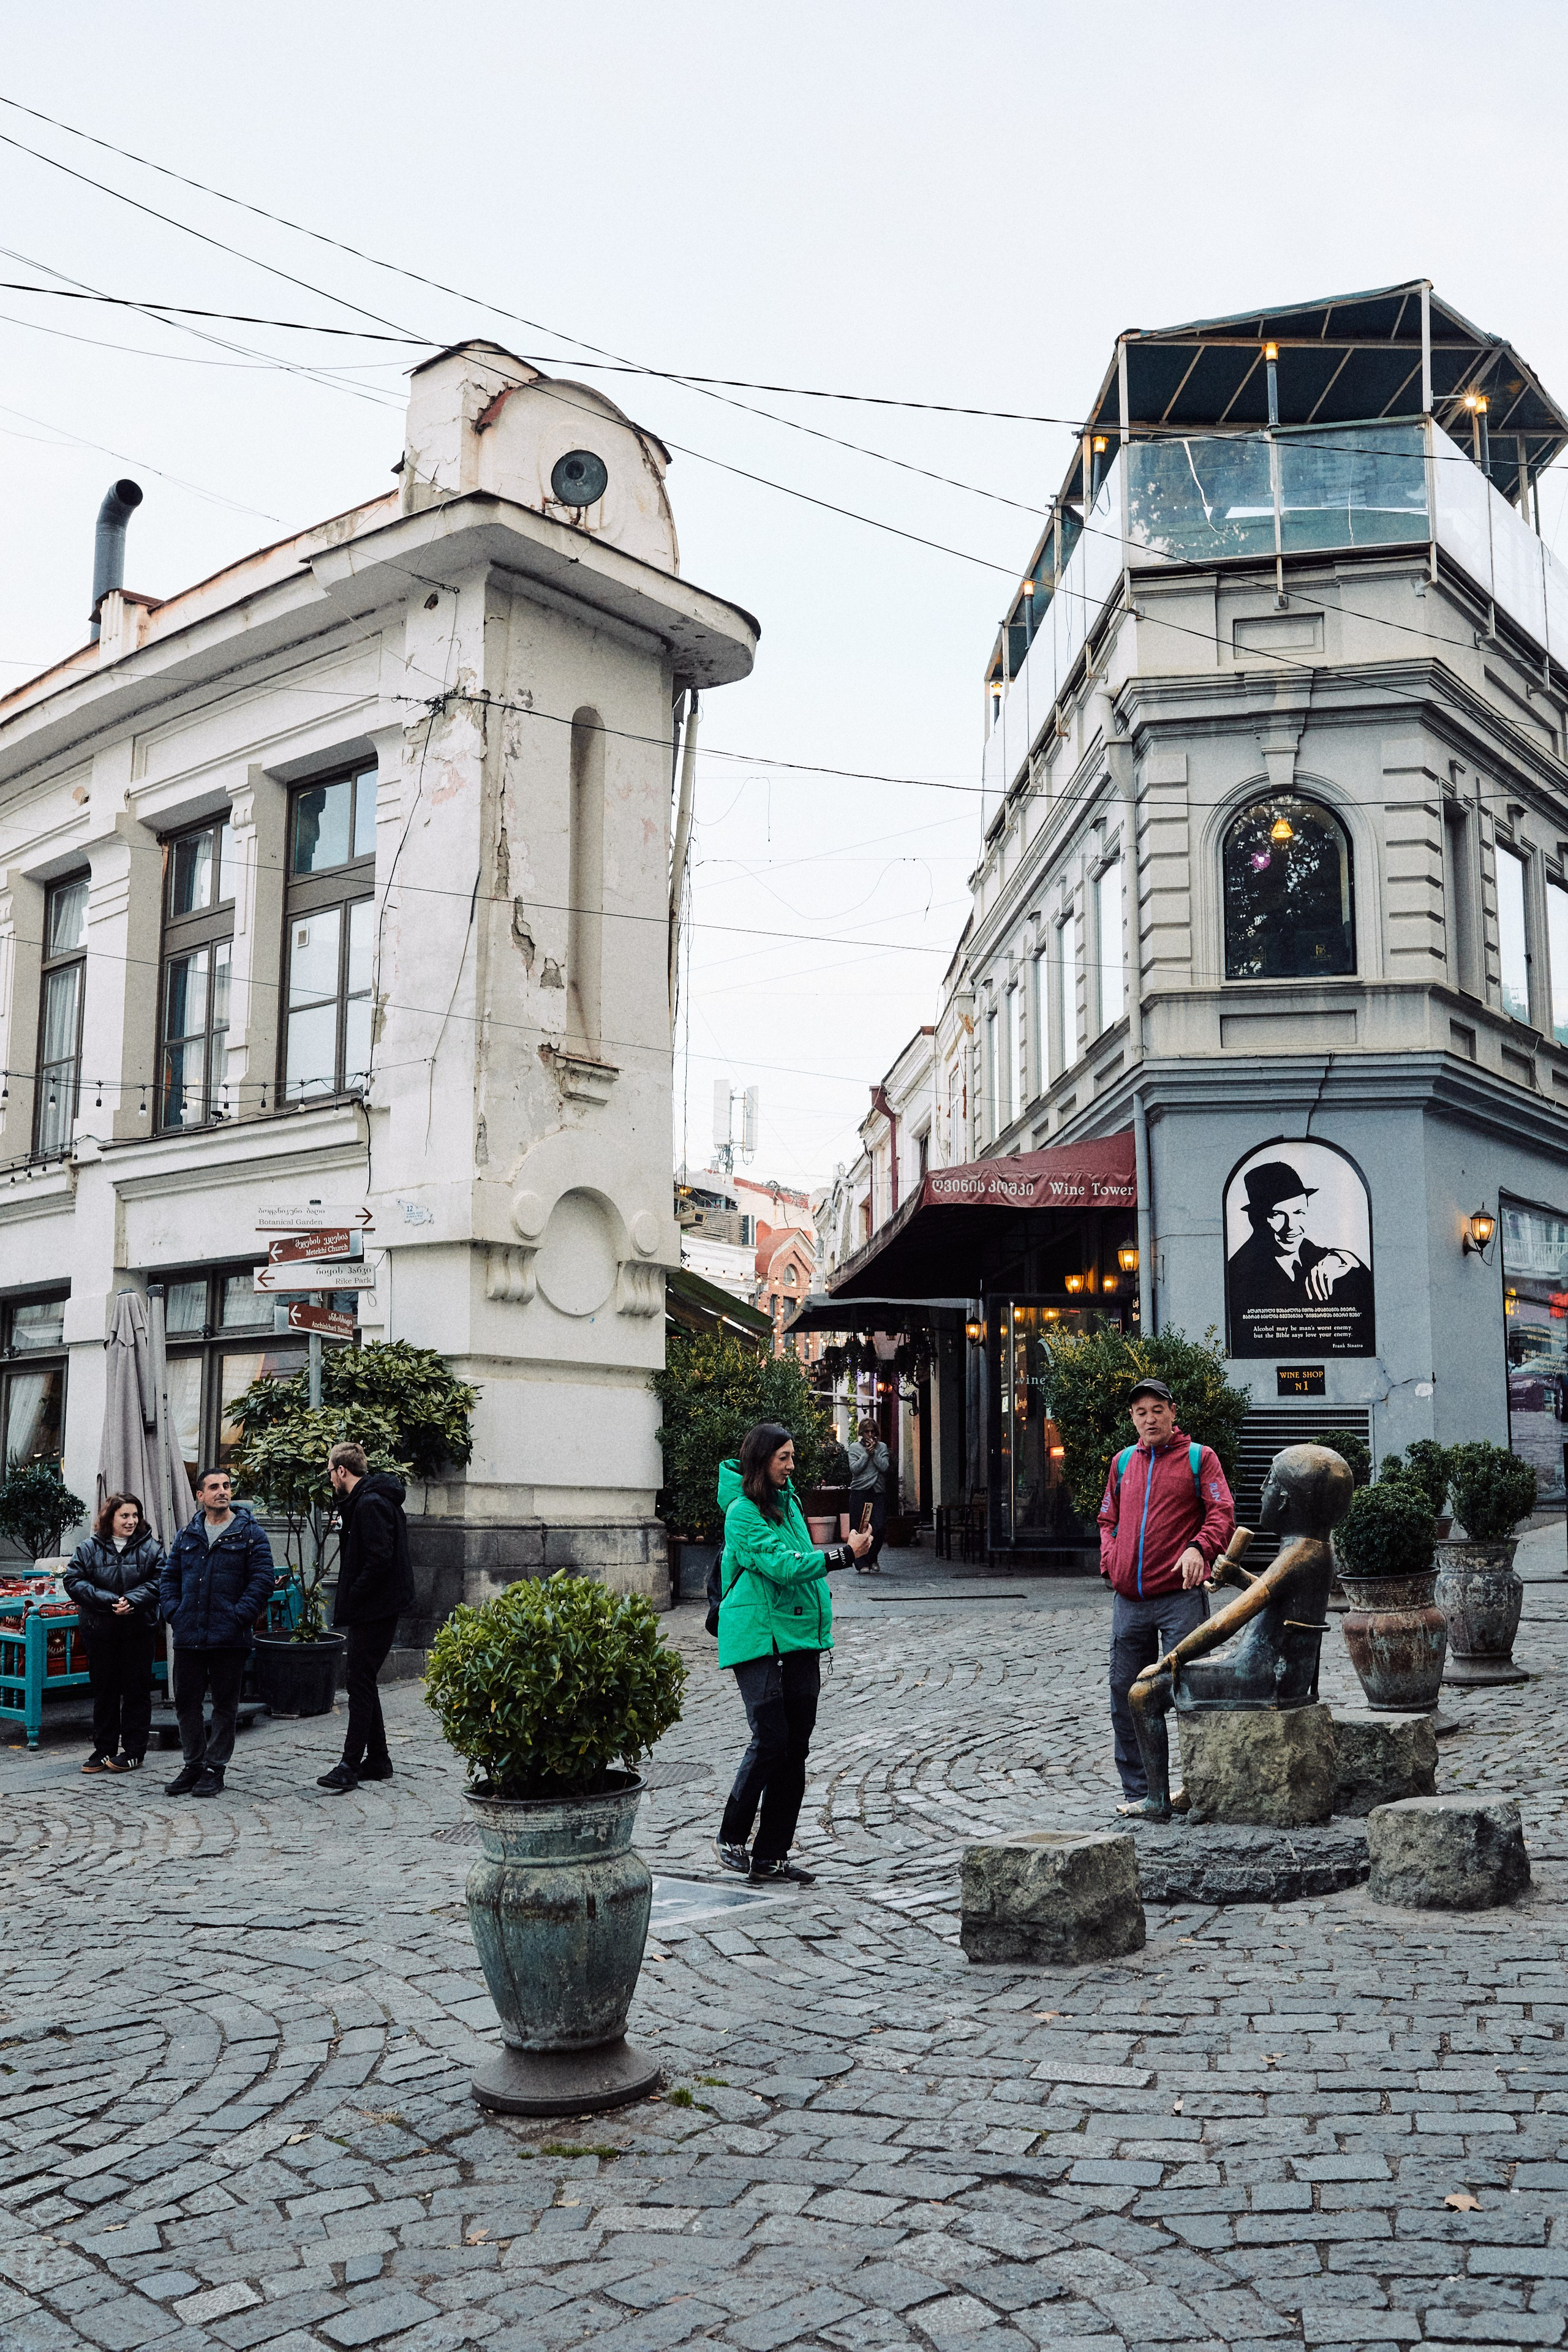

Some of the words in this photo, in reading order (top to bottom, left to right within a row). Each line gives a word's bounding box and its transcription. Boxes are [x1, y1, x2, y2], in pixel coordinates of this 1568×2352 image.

[932, 1179, 986, 1193] ღვინის
[988, 1180, 1034, 1196] კოშკი
[1049, 1182, 1085, 1195] Wine
[1091, 1182, 1134, 1196] Tower
[258, 1207, 303, 1215] ბოტანიკური
[306, 1207, 326, 1215] ბაღი
[295, 1236, 321, 1250] მეტეხის
[323, 1232, 349, 1245] ეკლესია
[306, 1246, 327, 1256] Metekhi
[328, 1243, 348, 1253] Church
[316, 1266, 343, 1277] რიყის
[348, 1265, 371, 1276] პარკი
[311, 1321, 337, 1332] Anchiskhati
[337, 1325, 353, 1335] Basilica
[1209, 1482, 1221, 1501] RUN
[1100, 1492, 1110, 1513] RUN
